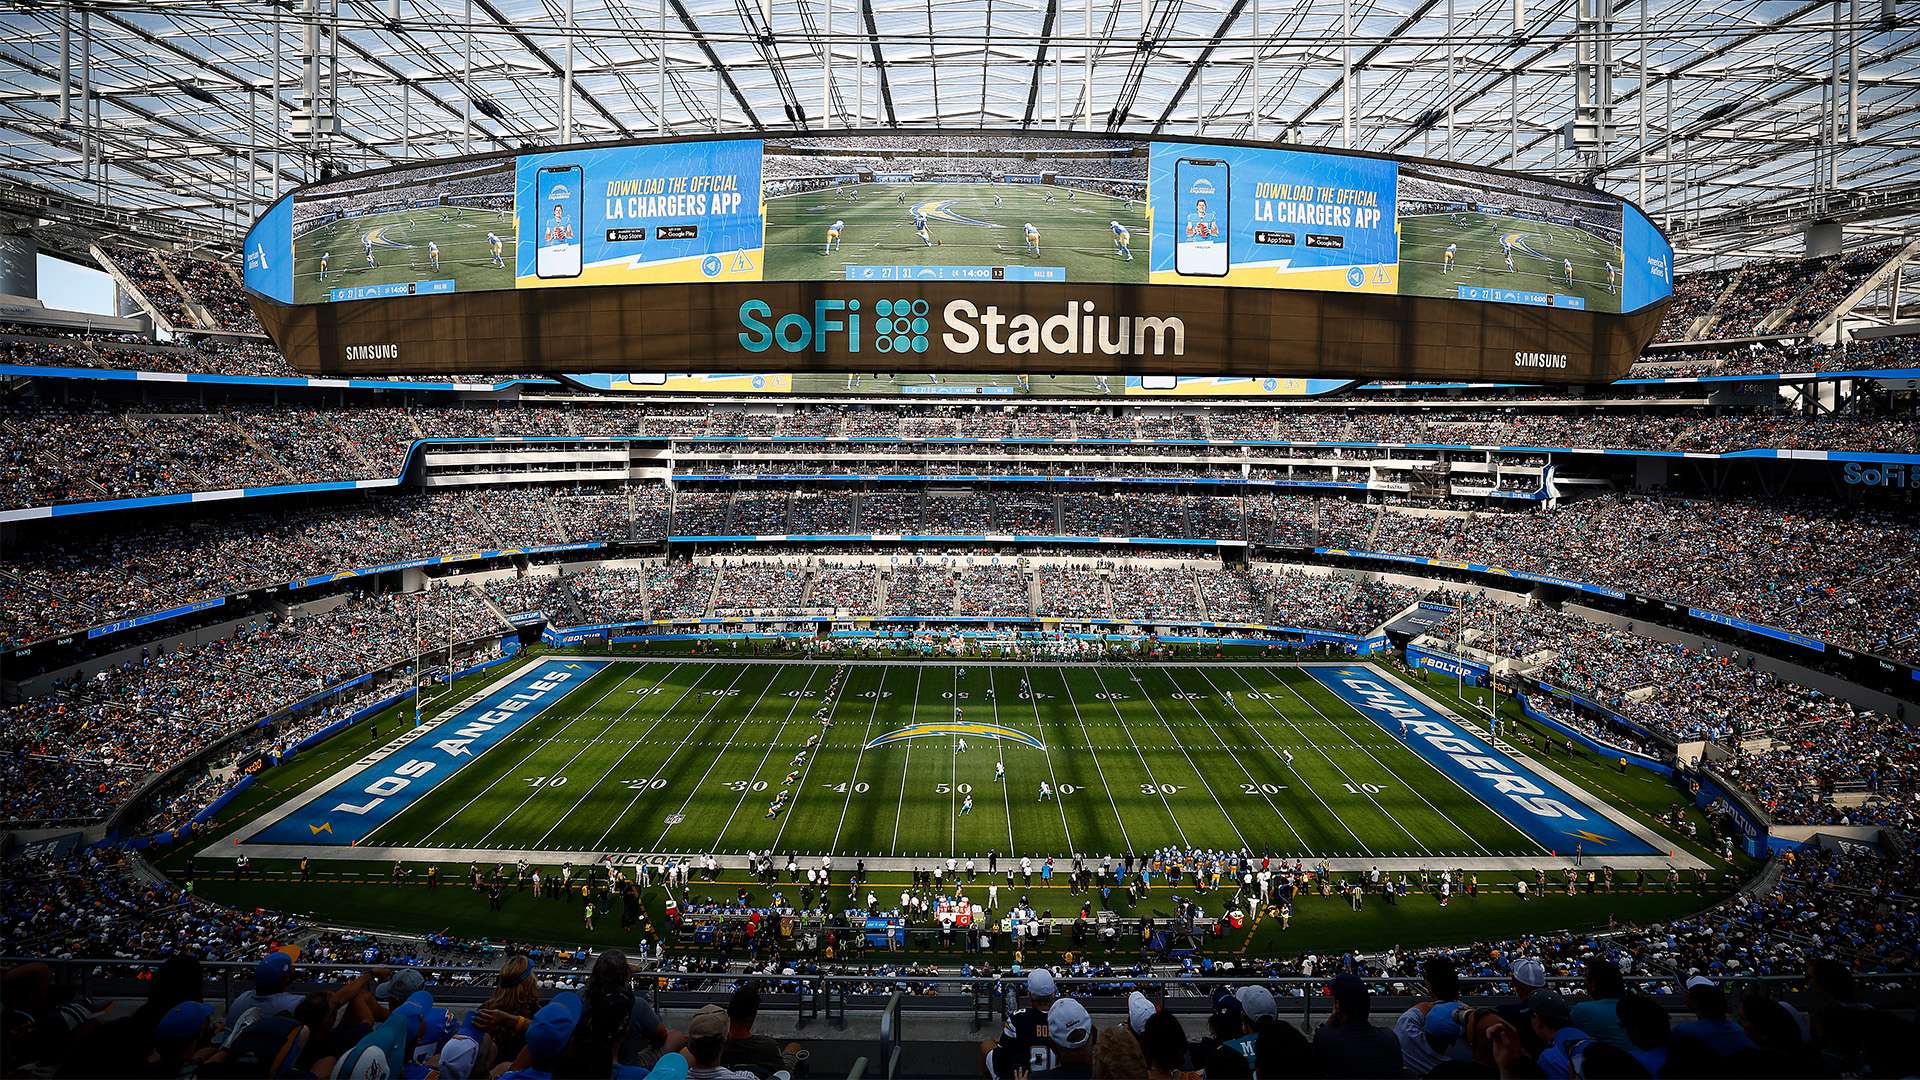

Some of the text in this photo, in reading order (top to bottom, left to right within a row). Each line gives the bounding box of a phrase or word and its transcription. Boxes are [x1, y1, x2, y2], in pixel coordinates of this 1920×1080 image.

[606, 175, 738, 197] DOWNLOAD THE OFFICIAL
[1255, 182, 1378, 207] DOWNLOAD THE OFFICIAL
[606, 192, 742, 220] LA CHARGERS APP
[1255, 200, 1381, 230] LA CHARGERS APP
[685, 230, 696, 238] Play
[1316, 239, 1342, 248] Google Play
[881, 268, 892, 278] 27
[902, 268, 912, 278] 31
[962, 269, 990, 277] 14:00
[1481, 289, 1489, 298] 27
[738, 299, 1184, 356] SoFi Stadium
[346, 344, 398, 361] SAMSUNG
[1514, 351, 1567, 369] SAMSUNG
[1843, 462, 1905, 488] SoFi
[112, 619, 137, 631] 27 31
[1420, 656, 1472, 676] #BOLTUP
[637, 687, 664, 696] 10
[713, 688, 741, 697] 20
[790, 689, 815, 698] 30
[868, 690, 893, 699] 40
[942, 691, 969, 700] 50
[1095, 692, 1122, 700] 30
[1171, 692, 1199, 700] 20
[1247, 692, 1276, 700] 10
[330, 671, 572, 815] LOS ANGELES
[1341, 678, 1588, 821] CHARGERS
[527, 776, 568, 788] 10
[626, 778, 667, 790] 20
[729, 780, 769, 791] 30
[832, 782, 870, 794] 40
[935, 783, 972, 794] 50
[1060, 783, 1075, 794] 0
[1140, 783, 1177, 795] 30
[1239, 783, 1279, 795] 20
[1341, 783, 1380, 794] 10
[598, 854, 694, 866] KICKOFF
[1036, 1024, 1049, 1037] BO
[1240, 1040, 1256, 1057] M
